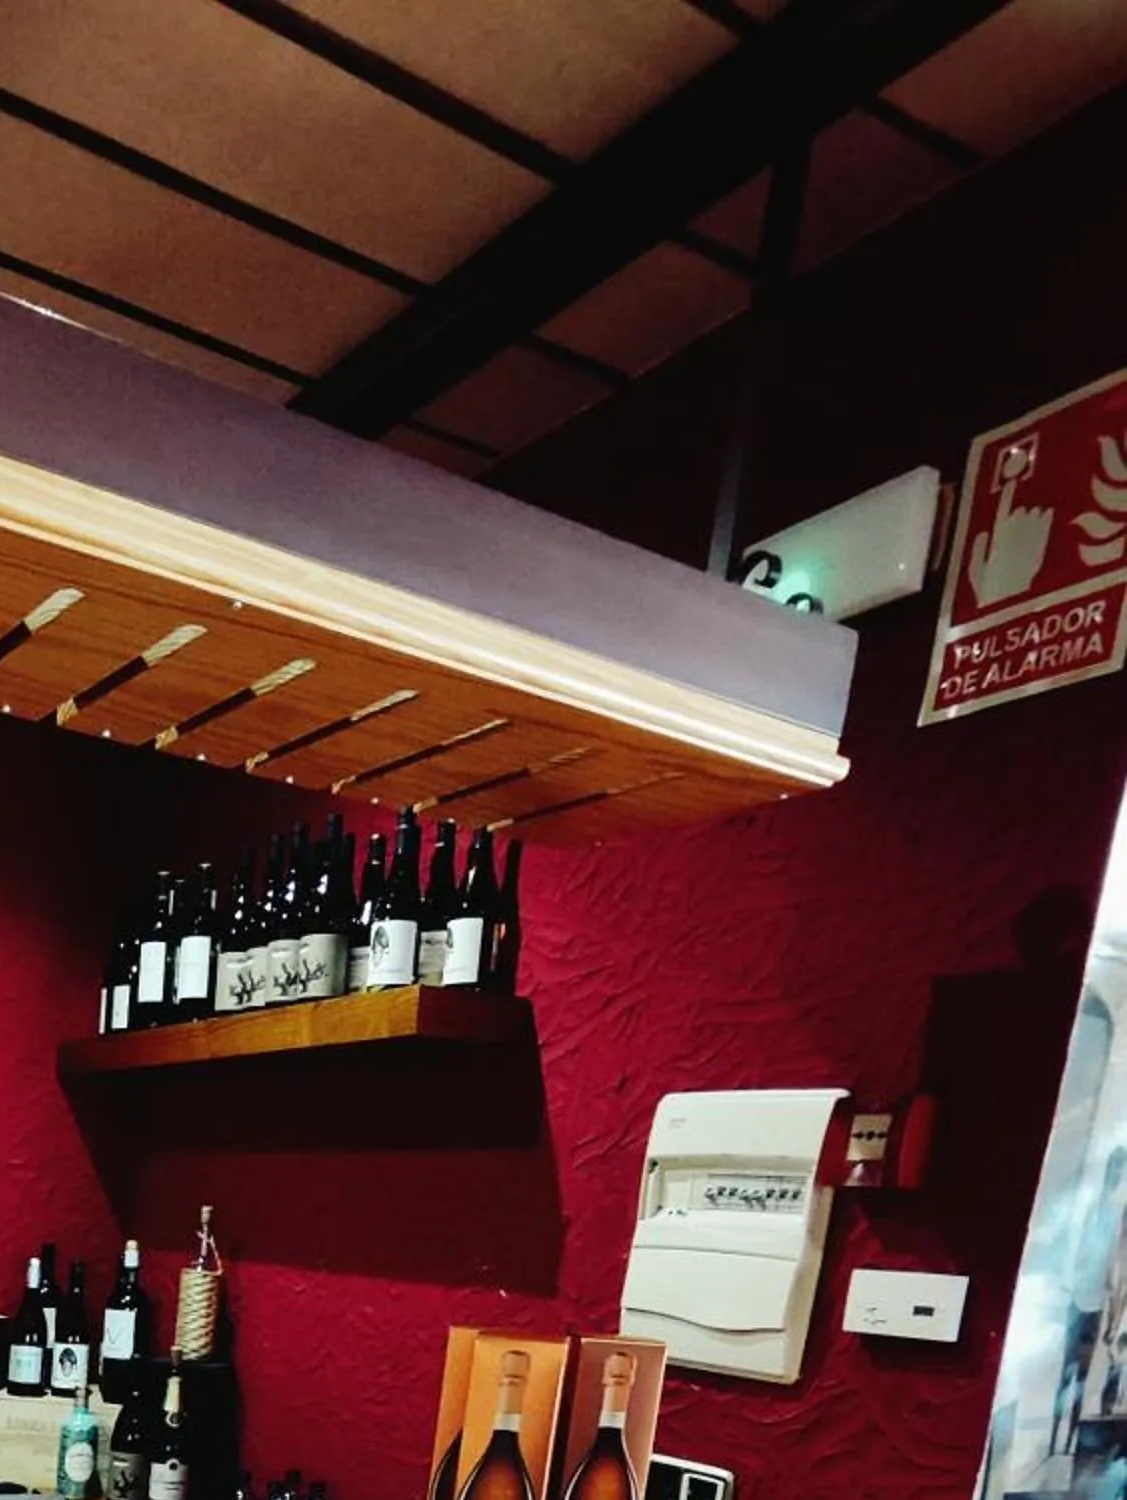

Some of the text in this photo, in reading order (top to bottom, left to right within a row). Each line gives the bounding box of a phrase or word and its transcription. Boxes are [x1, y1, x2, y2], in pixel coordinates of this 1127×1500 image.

[941, 631, 1105, 700] DE ALARMA
[952, 600, 1107, 669] PULSADOR
